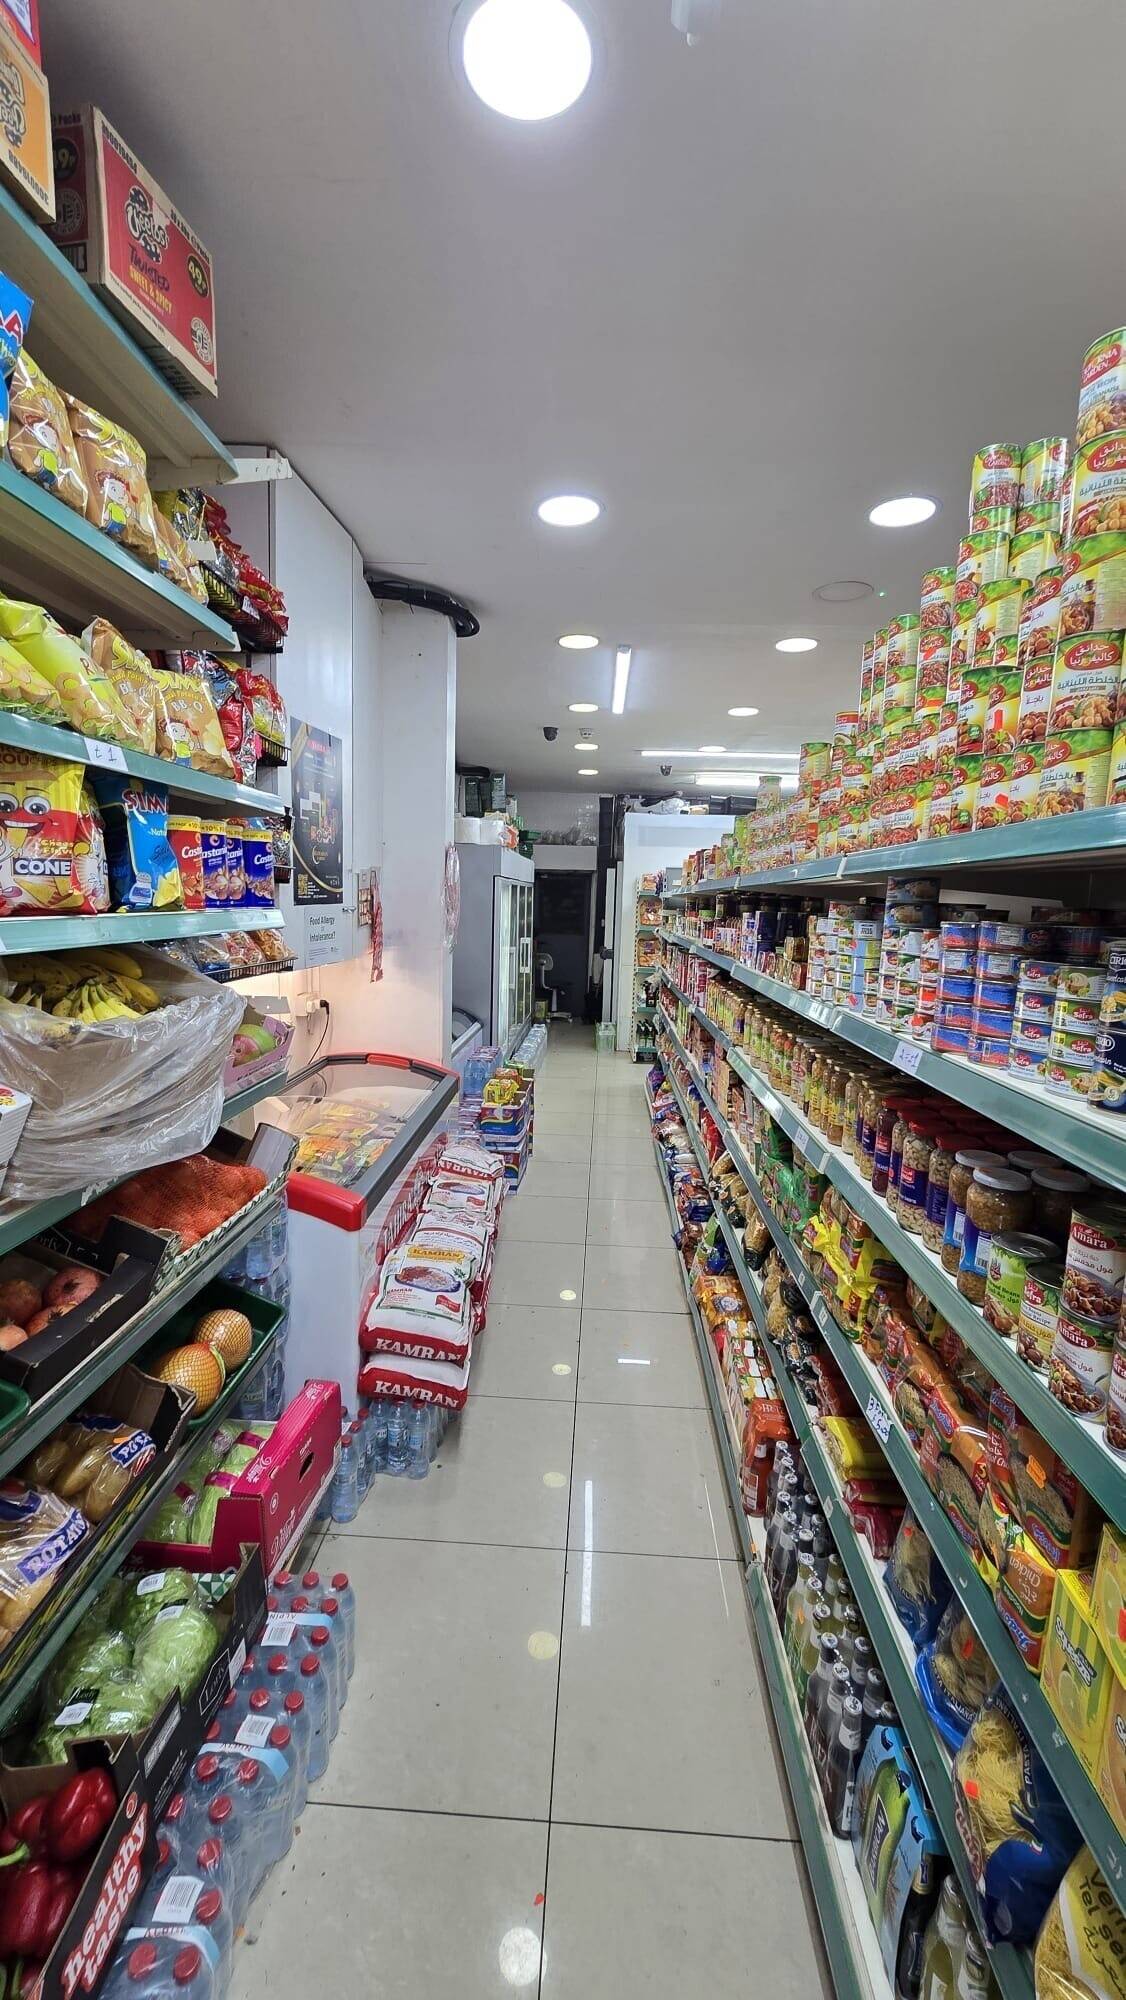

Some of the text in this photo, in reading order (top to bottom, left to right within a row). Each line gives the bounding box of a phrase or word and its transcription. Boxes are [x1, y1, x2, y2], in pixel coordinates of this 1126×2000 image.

[125, 199, 169, 250] Cheetos
[129, 264, 149, 293] SWEET
[310, 915, 335, 926] Food Allergy
[309, 931, 336, 942] Intolerance?
[1110, 955, 1126, 966] CIRI
[1025, 1000, 1041, 1009] Sofra
[1073, 1011, 1093, 1021] Sofra
[1023, 1030, 1041, 1039] Sofra
[1071, 1043, 1092, 1053] Sofra
[1015, 1056, 1030, 1067] Sofra
[1050, 1070, 1065, 1081] Sofra
[1072, 1227, 1108, 1249] Amara
[413, 1248, 461, 1259] KAMRAN
[375, 1337, 462, 1361] KAMRAN
[374, 1380, 460, 1409] KAMRAN
[868, 1397, 875, 1411] 3
[1009, 1556, 1041, 1588] Chicken
[1022, 1744, 1033, 1785] PASTA
[1080, 1875, 1100, 1917] Tel
[84, 1865, 140, 1987] taste
